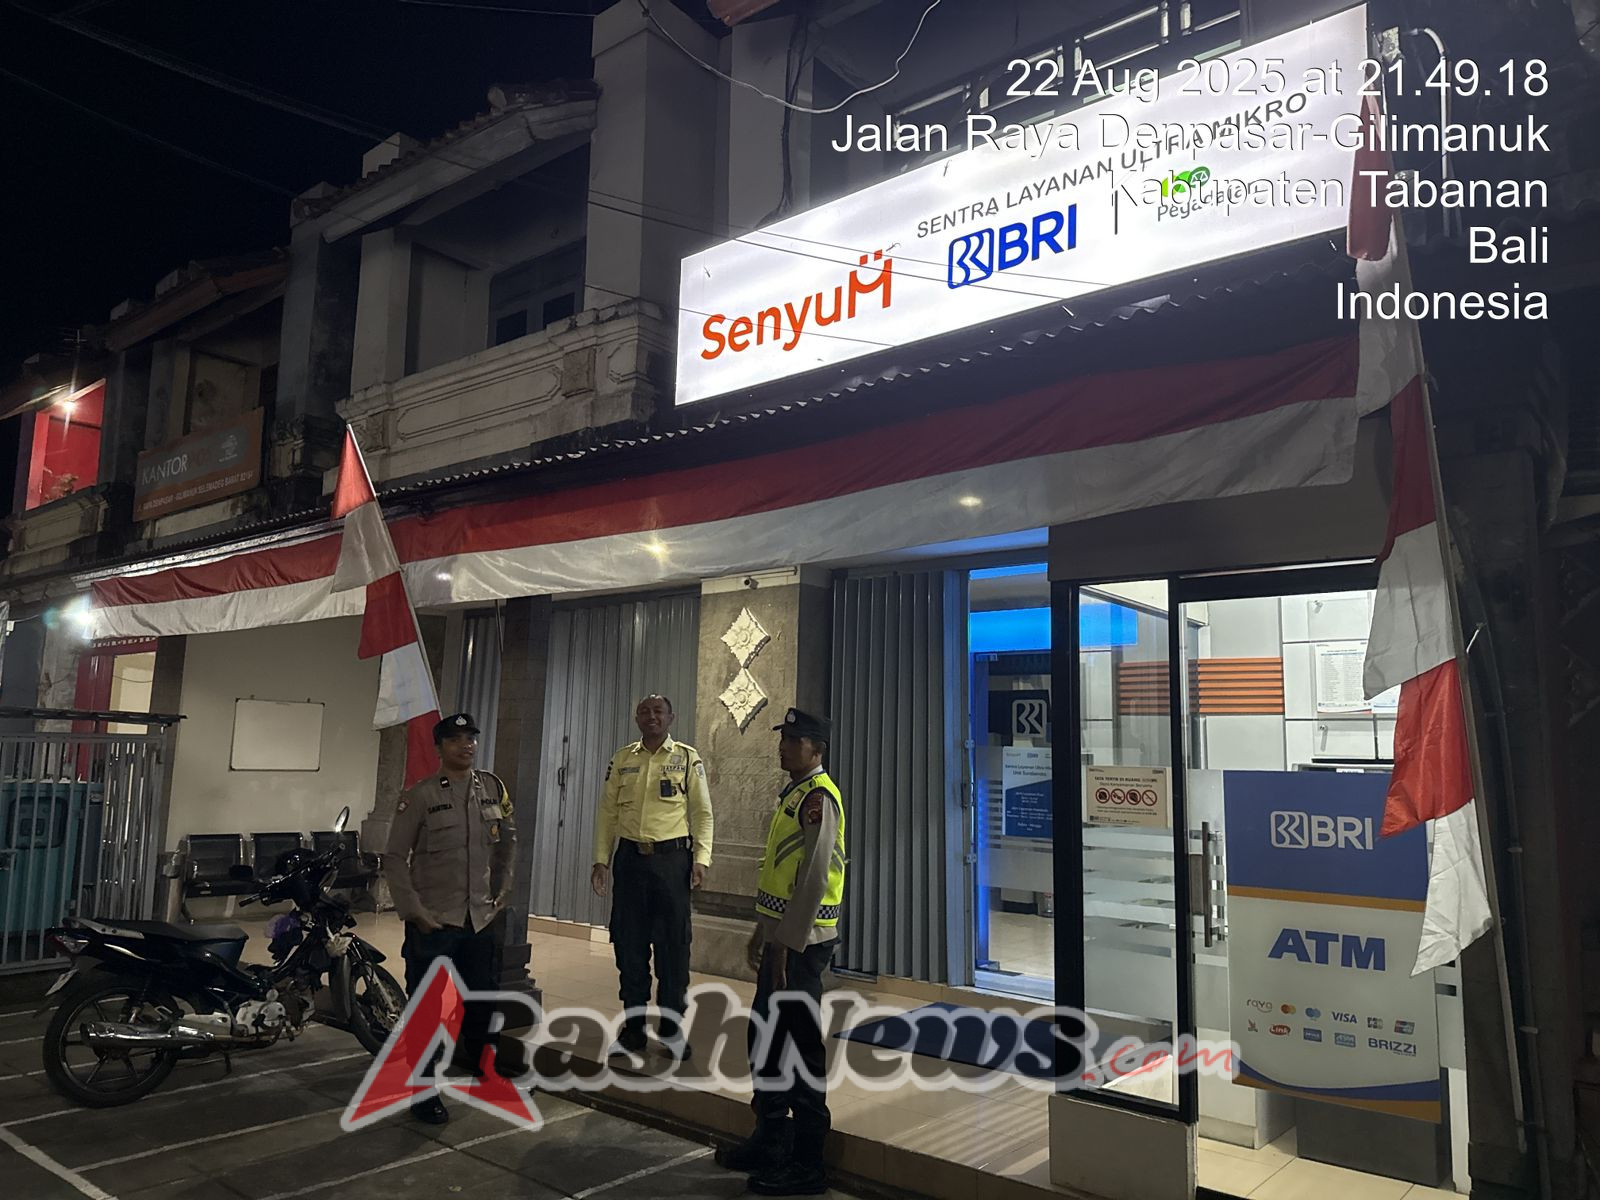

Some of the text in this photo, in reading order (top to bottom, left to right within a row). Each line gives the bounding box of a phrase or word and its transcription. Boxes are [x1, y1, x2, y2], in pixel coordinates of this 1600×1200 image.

[917, 197, 999, 239] SENTRA
[1006, 159, 1113, 209] LAYANAN
[1213, 92, 1307, 138] MIKRO
[998, 203, 1077, 272] BRI
[142, 454, 188, 486] KANTOR
[1311, 815, 1373, 850] BRI
[1268, 928, 1386, 971] ATM
[1332, 1011, 1358, 1024] VISA
[1368, 1038, 1417, 1055] BRIZZI
